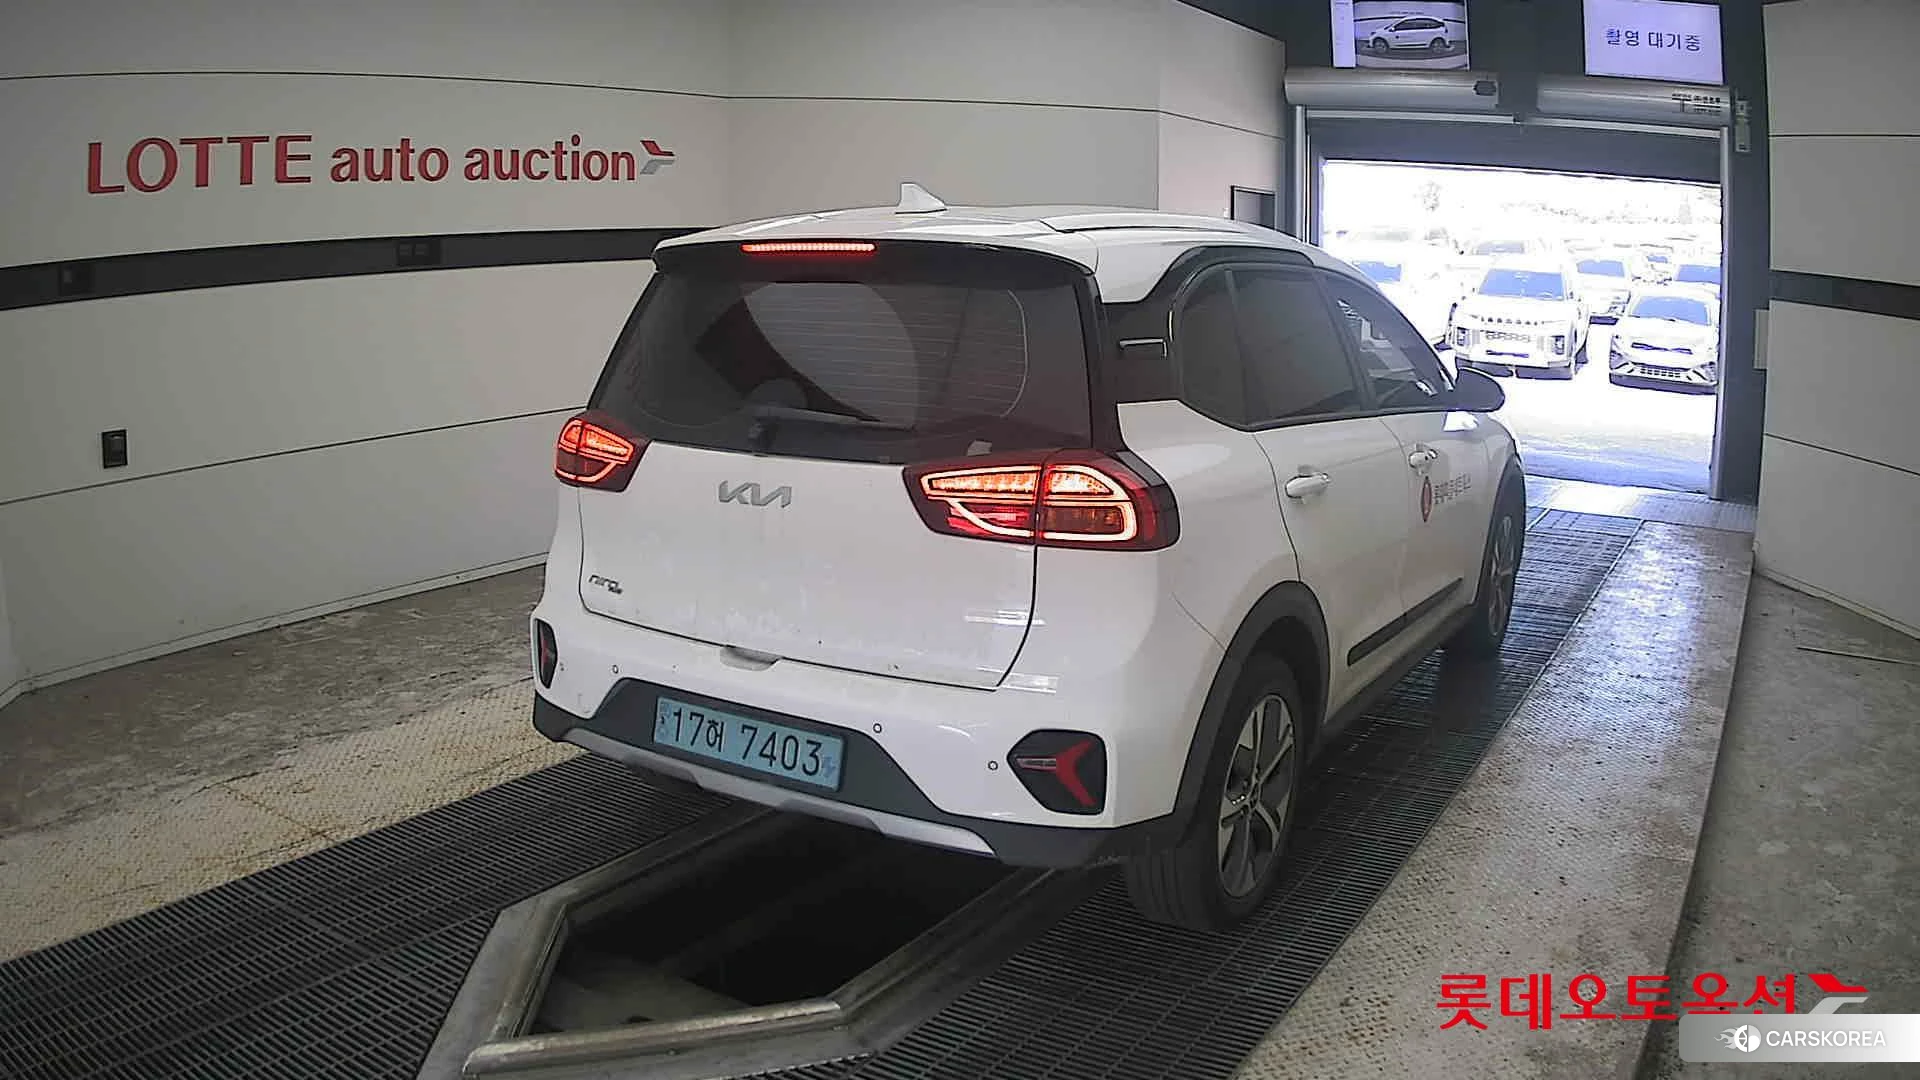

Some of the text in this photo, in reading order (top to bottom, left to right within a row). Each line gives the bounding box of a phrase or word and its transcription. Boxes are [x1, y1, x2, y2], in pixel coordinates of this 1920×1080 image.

[1647, 31, 1701, 51] 대기중
[87, 134, 635, 194] LOTTE auto auction
[718, 480, 793, 508] KIA
[673, 707, 823, 777] 17허 7403
